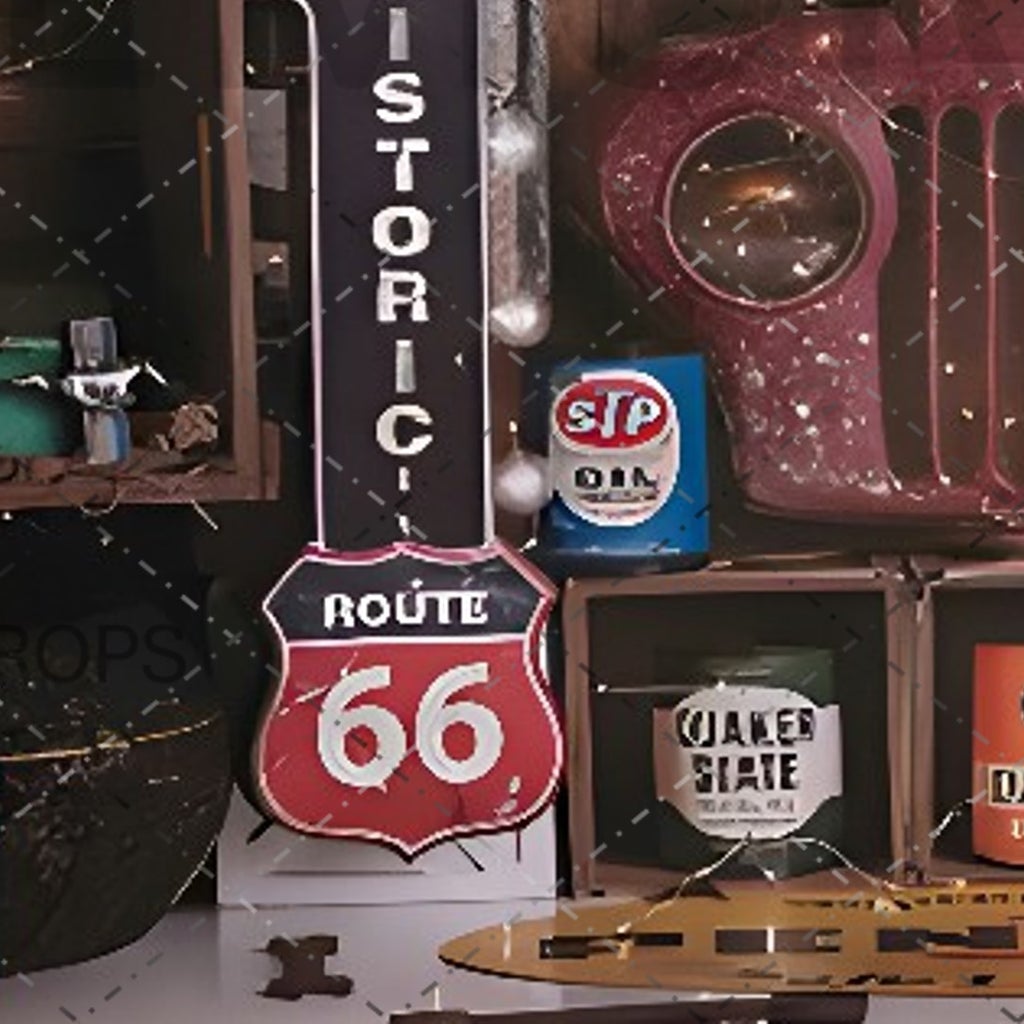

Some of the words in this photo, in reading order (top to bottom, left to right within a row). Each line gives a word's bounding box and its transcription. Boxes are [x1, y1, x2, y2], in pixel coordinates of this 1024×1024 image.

[565, 388, 661, 439] STP
[323, 589, 489, 629] ROUTE
[317, 661, 504, 789] 66
